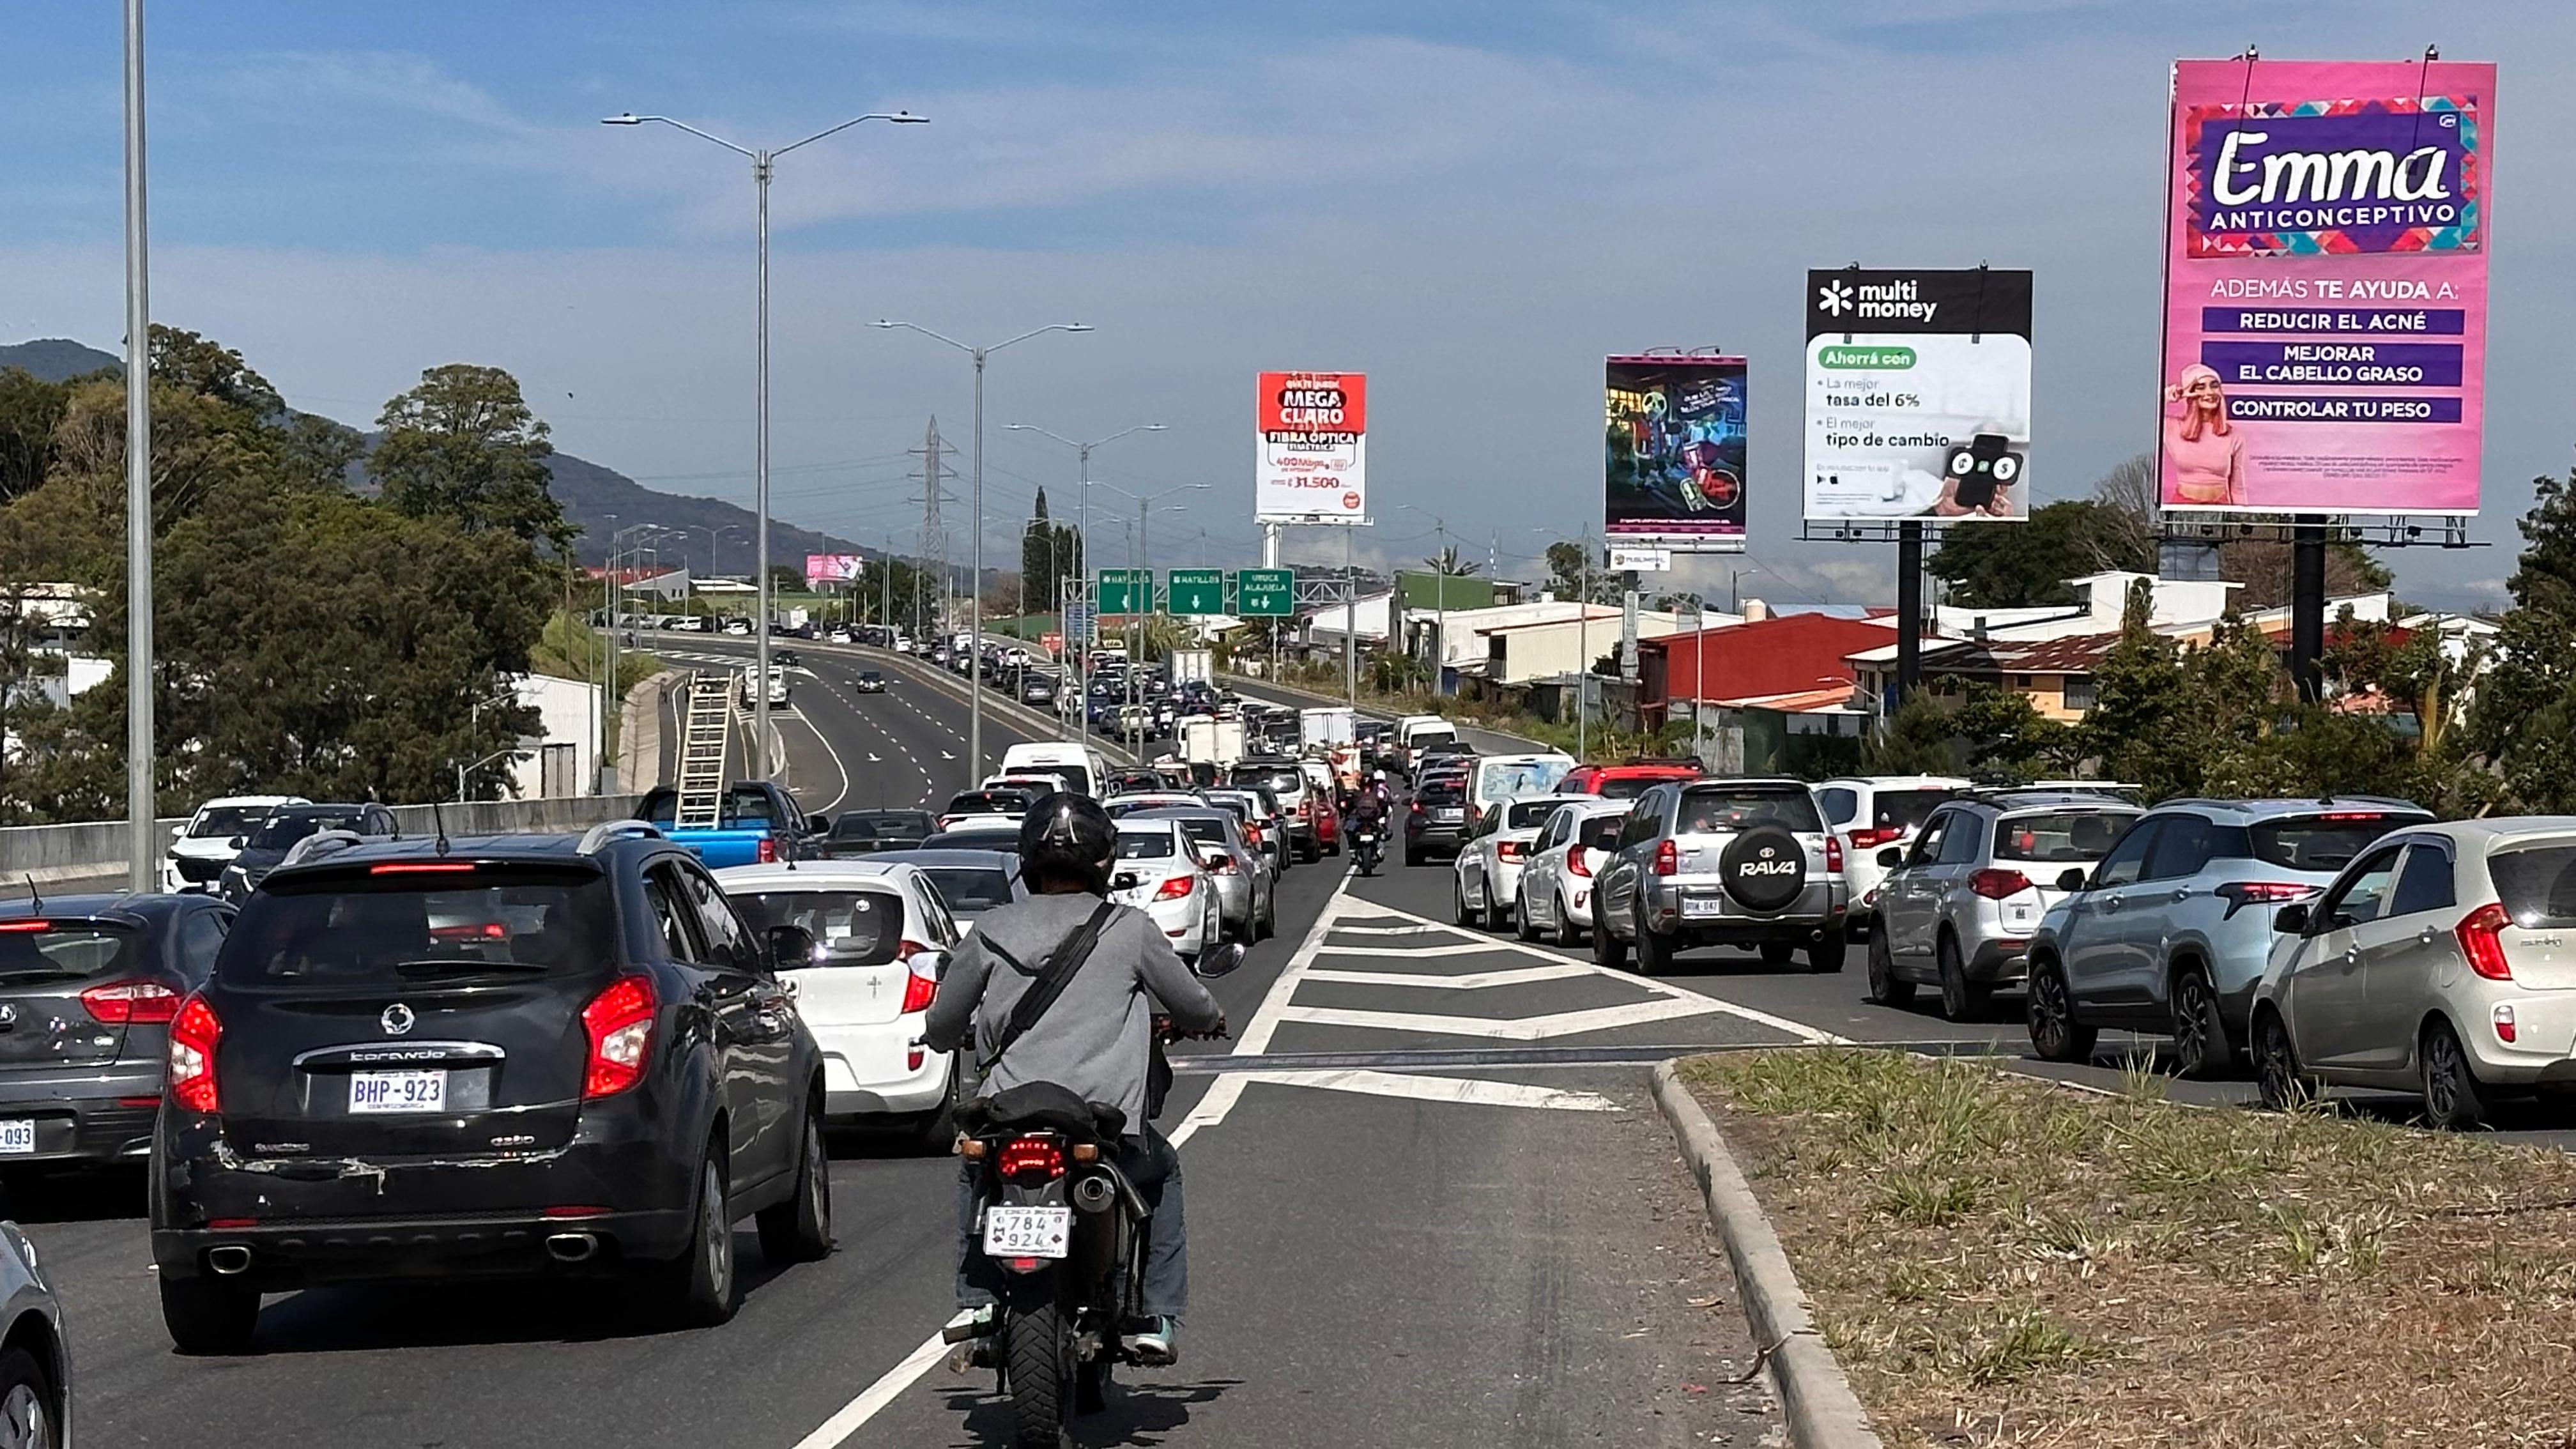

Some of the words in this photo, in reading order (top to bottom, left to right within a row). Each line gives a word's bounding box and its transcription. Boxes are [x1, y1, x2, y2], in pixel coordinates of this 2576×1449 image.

[2210, 130, 2450, 206] Emma
[2209, 204, 2456, 231] ANTICONCEPTIVO
[1859, 279, 1917, 301] multi
[2211, 276, 2309, 299] ADEMÁS
[2317, 280, 2343, 299] TE
[2349, 280, 2430, 300] AYUDA
[2436, 282, 2460, 300] A:
[1859, 301, 1938, 322] money
[2239, 312, 2333, 330] REDUCIR
[2338, 312, 2363, 330] EL
[2368, 310, 2427, 330] ACNÉ
[2283, 345, 2375, 363] MEJORAR
[2239, 365, 2260, 380] EL
[2264, 365, 2354, 381] CABELLO
[2358, 365, 2423, 382] GRASO
[1844, 379, 1878, 392] mejor
[1284, 392, 1341, 407] MEGA
[1826, 395, 1860, 406] tasa
[1865, 394, 1890, 406] del
[1895, 394, 1920, 406] 6%
[1280, 408, 1344, 424] CLARO
[2231, 400, 2349, 418] CONTROLAR
[2352, 401, 2377, 418] TU
[2381, 401, 2431, 418] PESO
[1841, 419, 1875, 431] mejor
[1270, 432, 1307, 442] FIBRA
[1826, 434, 1859, 449] tipo
[1864, 434, 1883, 446] de
[1890, 433, 1949, 447] cambio
[1740, 861, 1796, 877] RAV4
[355, 1080, 440, 1102] BHP-923
[1009, 1217, 1046, 1230] 784
[1008, 1234, 1043, 1246] 924
